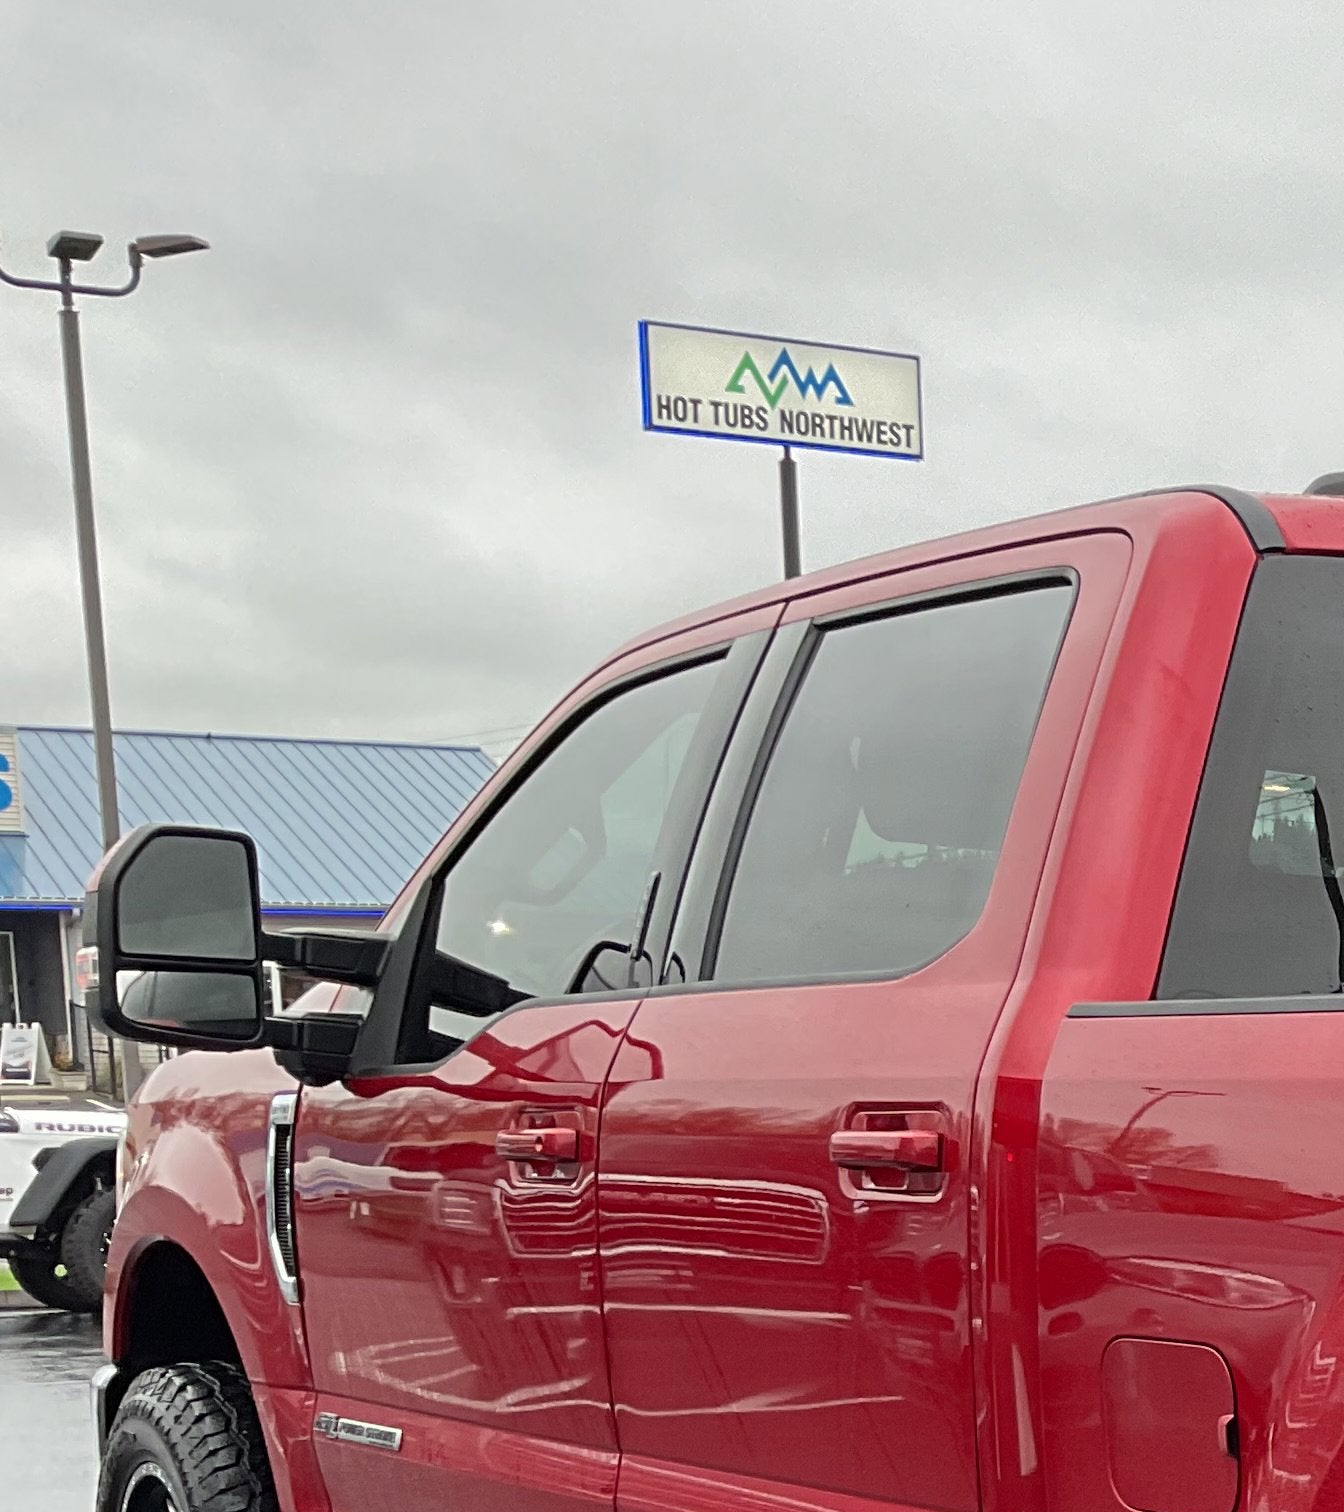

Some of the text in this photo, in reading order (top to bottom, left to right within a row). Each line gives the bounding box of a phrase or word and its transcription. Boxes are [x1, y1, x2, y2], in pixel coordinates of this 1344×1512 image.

[656, 394, 915, 448] HOT TUBS NORTHWEST
